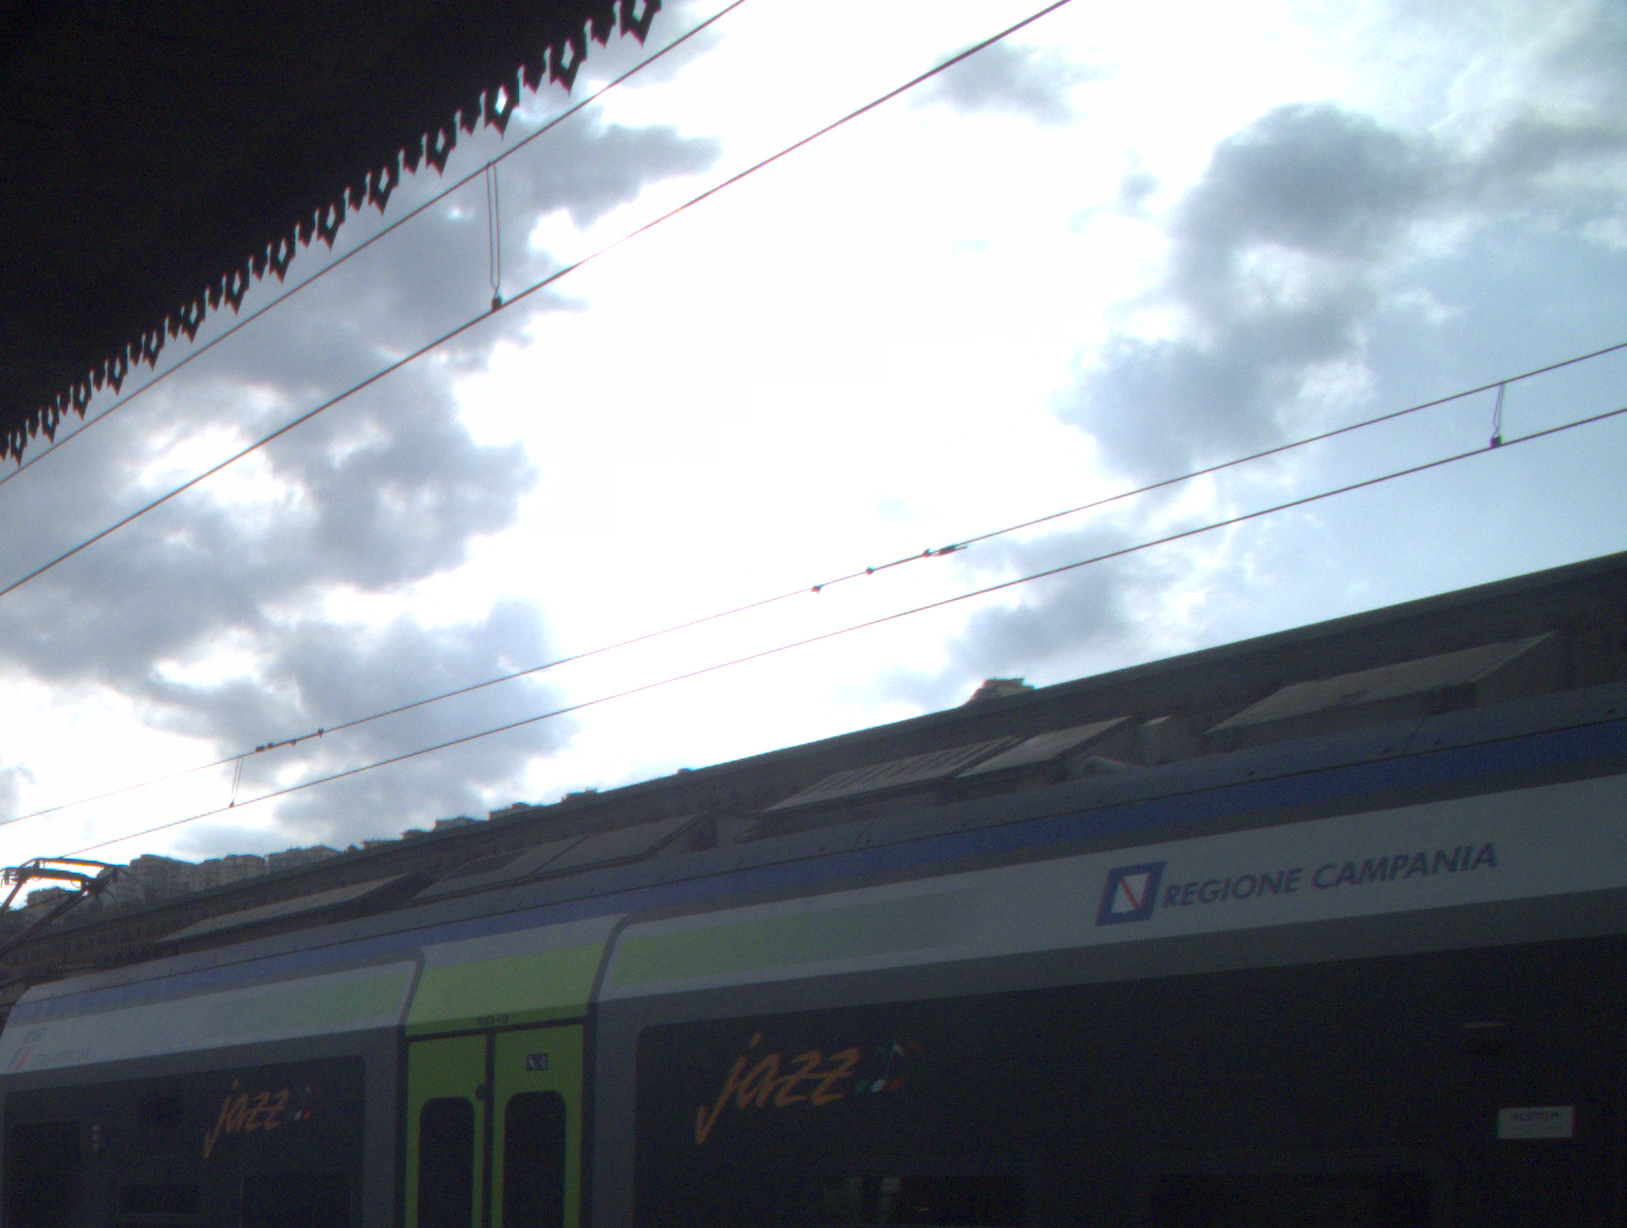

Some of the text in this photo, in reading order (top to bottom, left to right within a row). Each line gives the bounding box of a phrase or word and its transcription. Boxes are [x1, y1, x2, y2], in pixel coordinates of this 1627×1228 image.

[1163, 842, 1498, 908] REGIONE CAMPANIA
[204, 1078, 289, 1159] jazz
[695, 1031, 861, 1144] jazz
